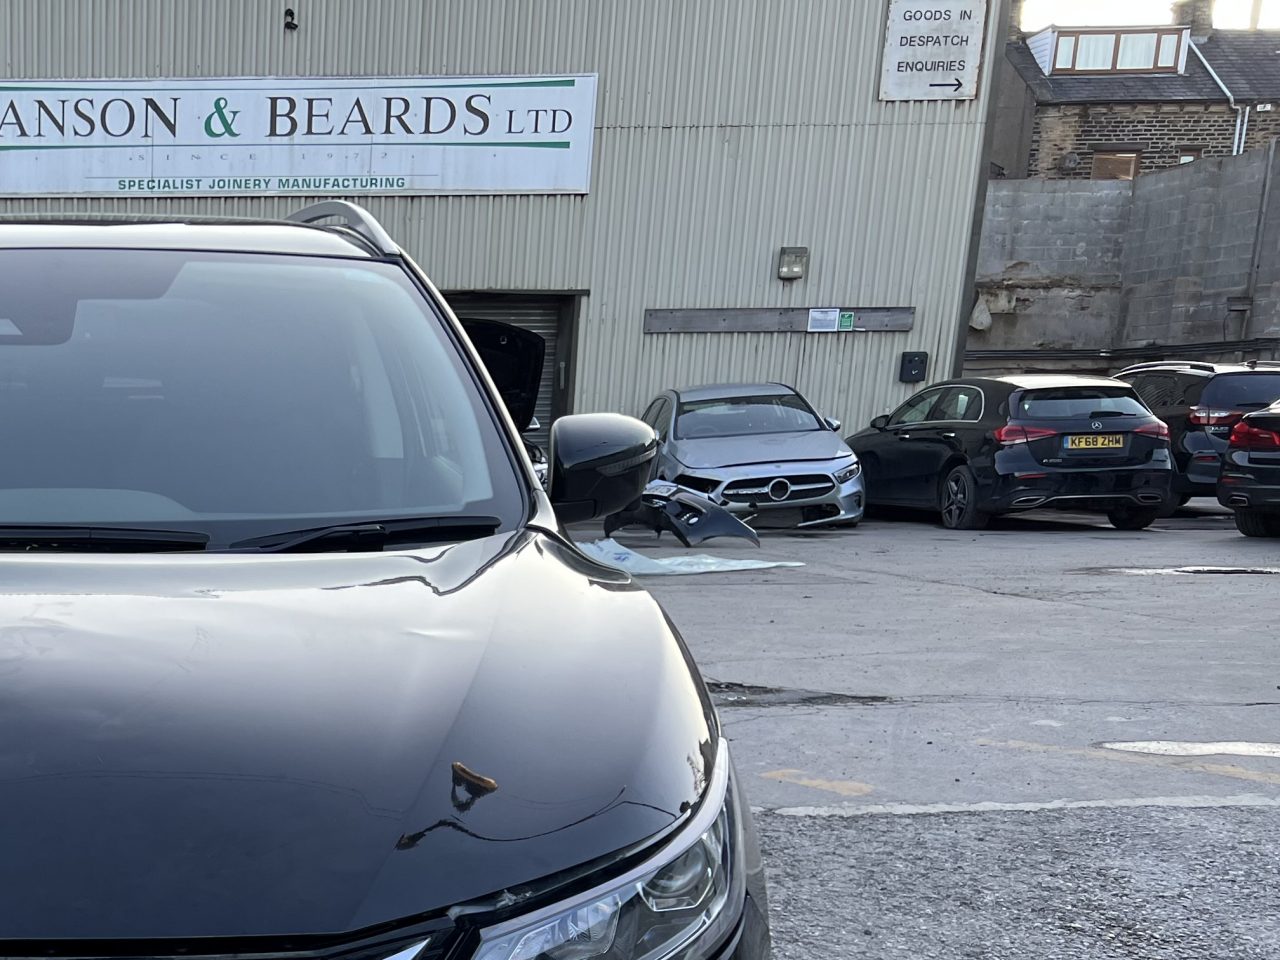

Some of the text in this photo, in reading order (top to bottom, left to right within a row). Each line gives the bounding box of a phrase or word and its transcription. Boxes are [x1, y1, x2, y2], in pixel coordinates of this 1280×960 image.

[903, 10, 972, 21] GOODS IN
[900, 35, 969, 47] DESPATCH
[897, 60, 966, 72] ENQUIRIES
[204, 97, 241, 138] &
[265, 94, 491, 138] BEARDS
[505, 109, 573, 135] LTD
[118, 177, 406, 190] SPECIALIST JOINERY MANUFACTURING
[1070, 436, 1098, 447] KF68
